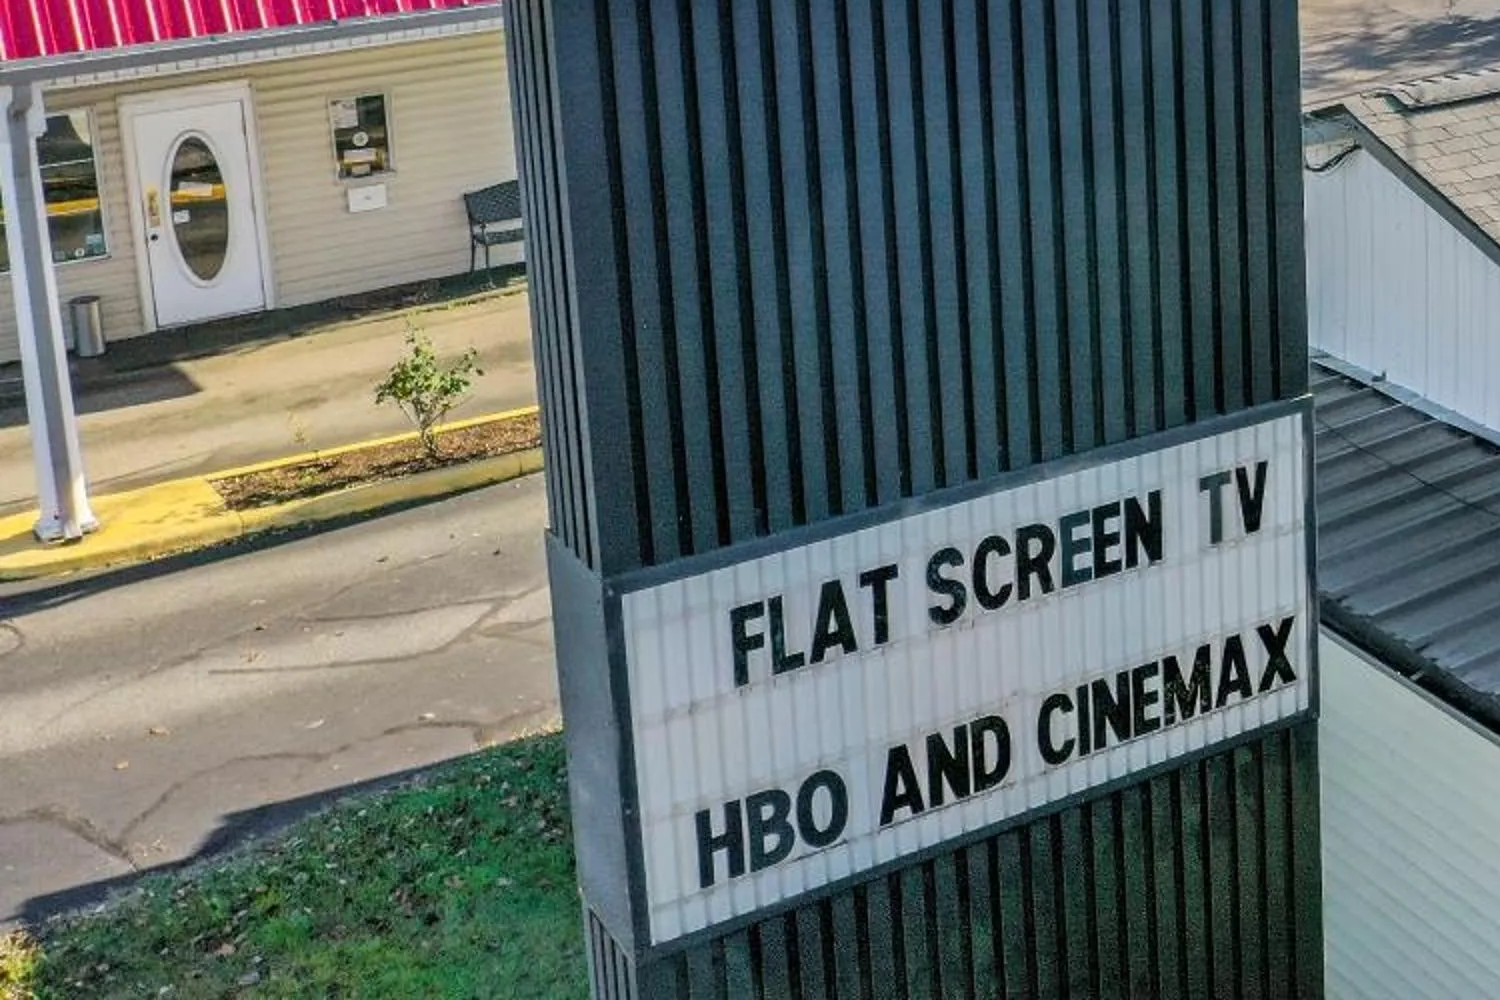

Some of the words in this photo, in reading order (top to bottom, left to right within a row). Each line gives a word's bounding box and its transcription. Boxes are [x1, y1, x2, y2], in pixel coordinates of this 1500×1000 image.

[730, 564, 898, 688] FLAT
[926, 490, 1164, 629] SCREEN
[1199, 460, 1269, 546] TV
[695, 769, 849, 889] HBO
[880, 715, 1012, 827] AND
[1037, 616, 1297, 766] CINEMAX
